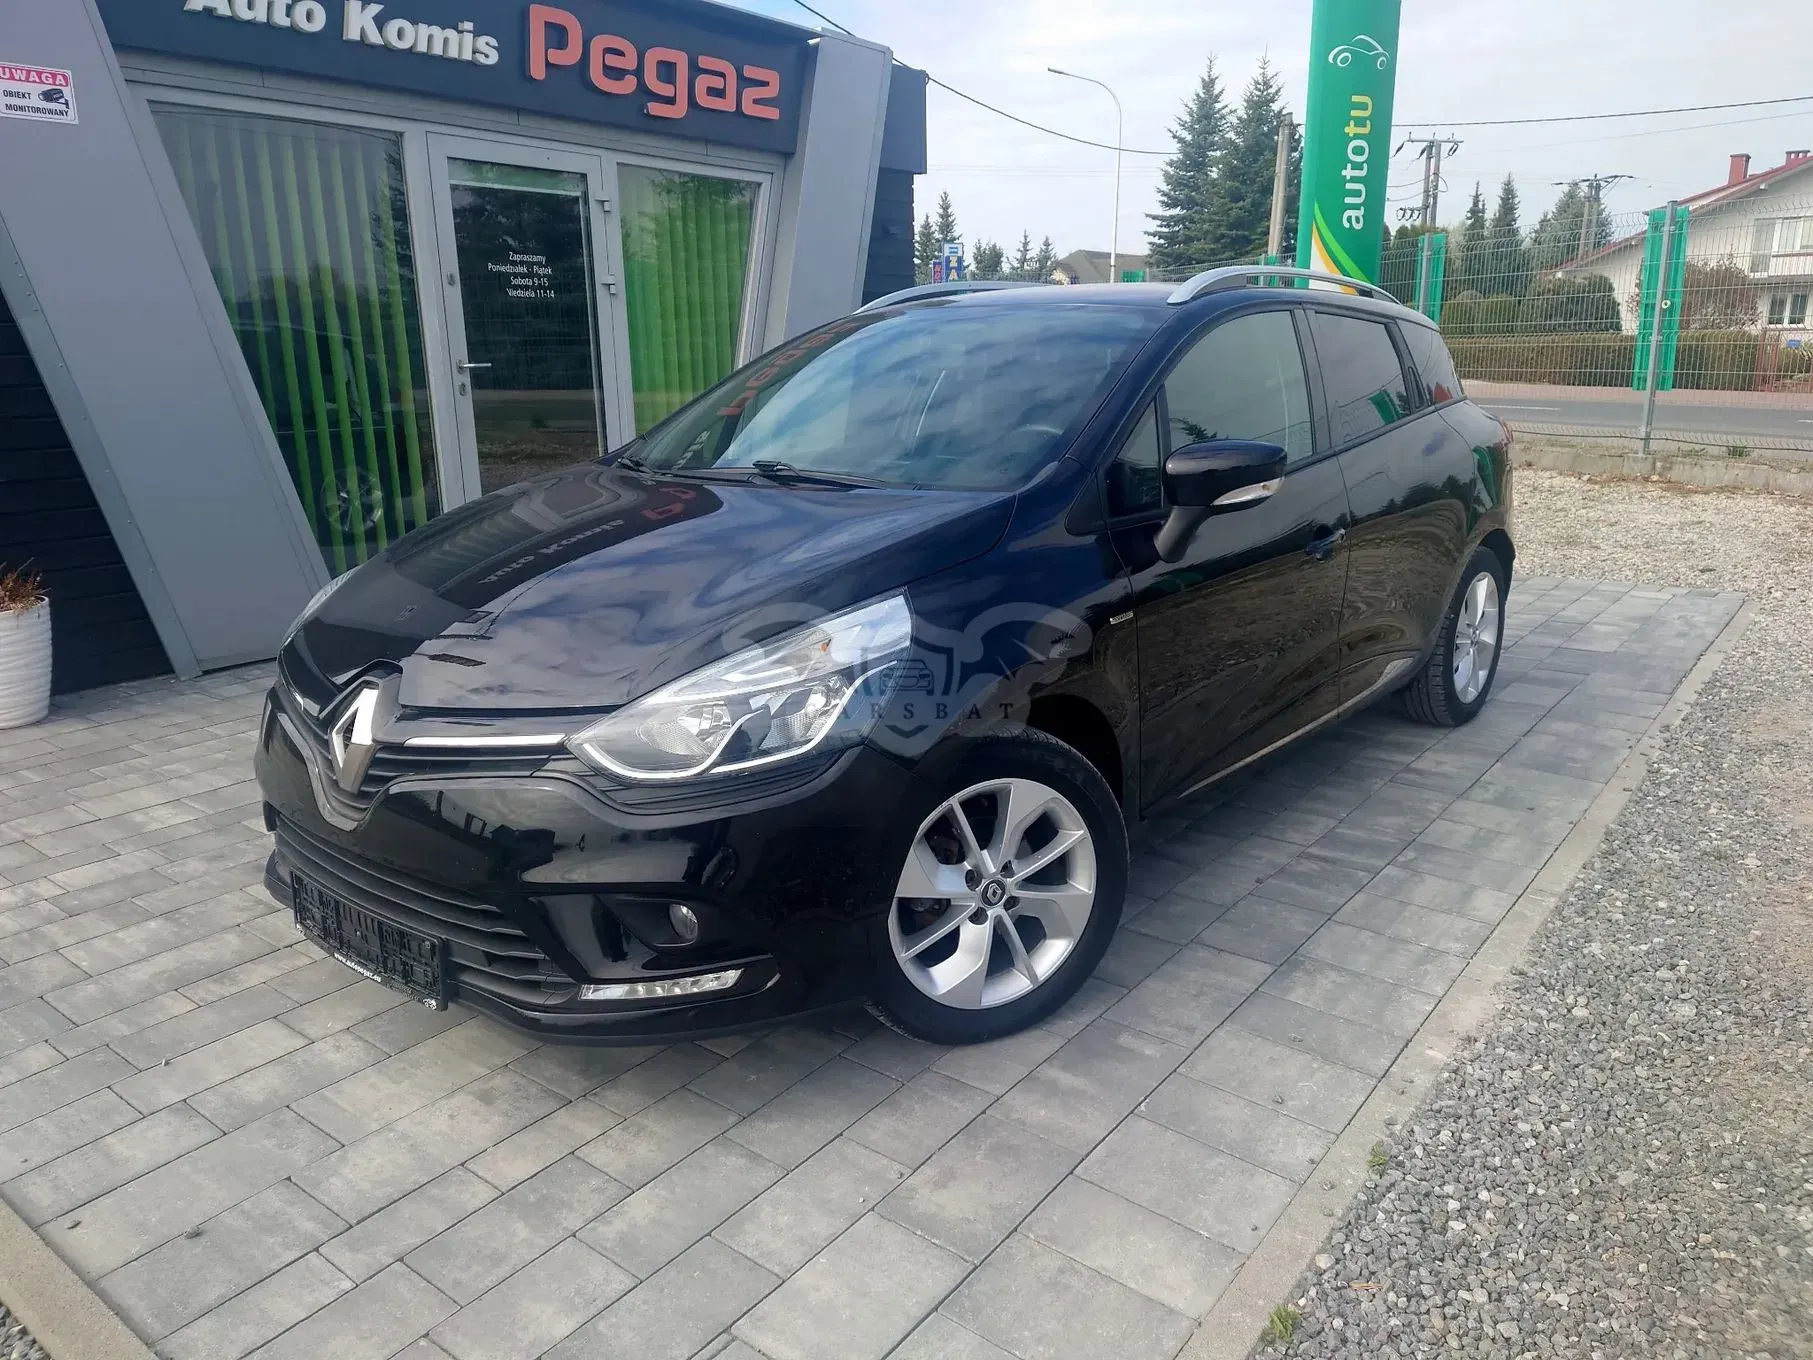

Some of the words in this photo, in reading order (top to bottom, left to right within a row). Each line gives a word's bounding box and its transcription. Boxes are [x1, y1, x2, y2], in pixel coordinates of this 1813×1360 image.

[342, 0, 499, 66] Komis
[528, 3, 781, 120] Pegaz
[0, 67, 67, 86] UWAGA
[3, 89, 32, 100] OBIEKT
[5, 103, 69, 117] MONITOROWANY
[508, 251, 546, 265] Zapraszamy
[487, 262, 528, 274] Poniedziałek
[533, 265, 553, 277] Piątek
[510, 276, 533, 287] Sobota
[533, 277, 549, 287] 9-15
[536, 289, 555, 298] 11-14
